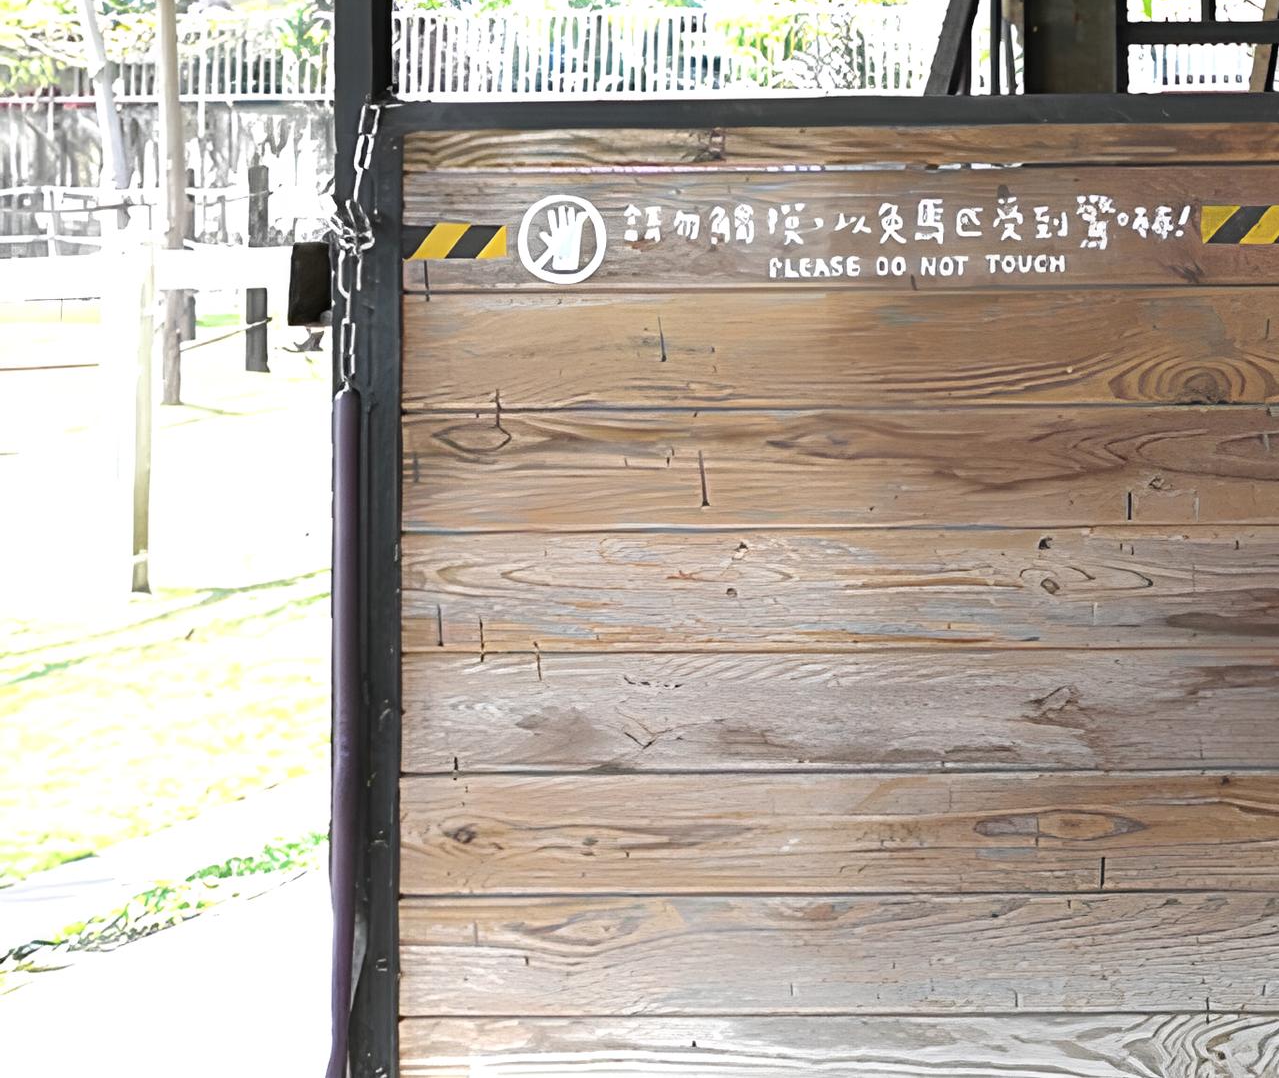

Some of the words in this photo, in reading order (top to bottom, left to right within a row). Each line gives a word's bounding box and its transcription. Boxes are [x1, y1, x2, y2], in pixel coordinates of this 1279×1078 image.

[769, 255, 861, 278] PLEASE
[876, 255, 907, 276] DO
[921, 255, 969, 276] NOT
[986, 254, 1066, 275] TOUCH
